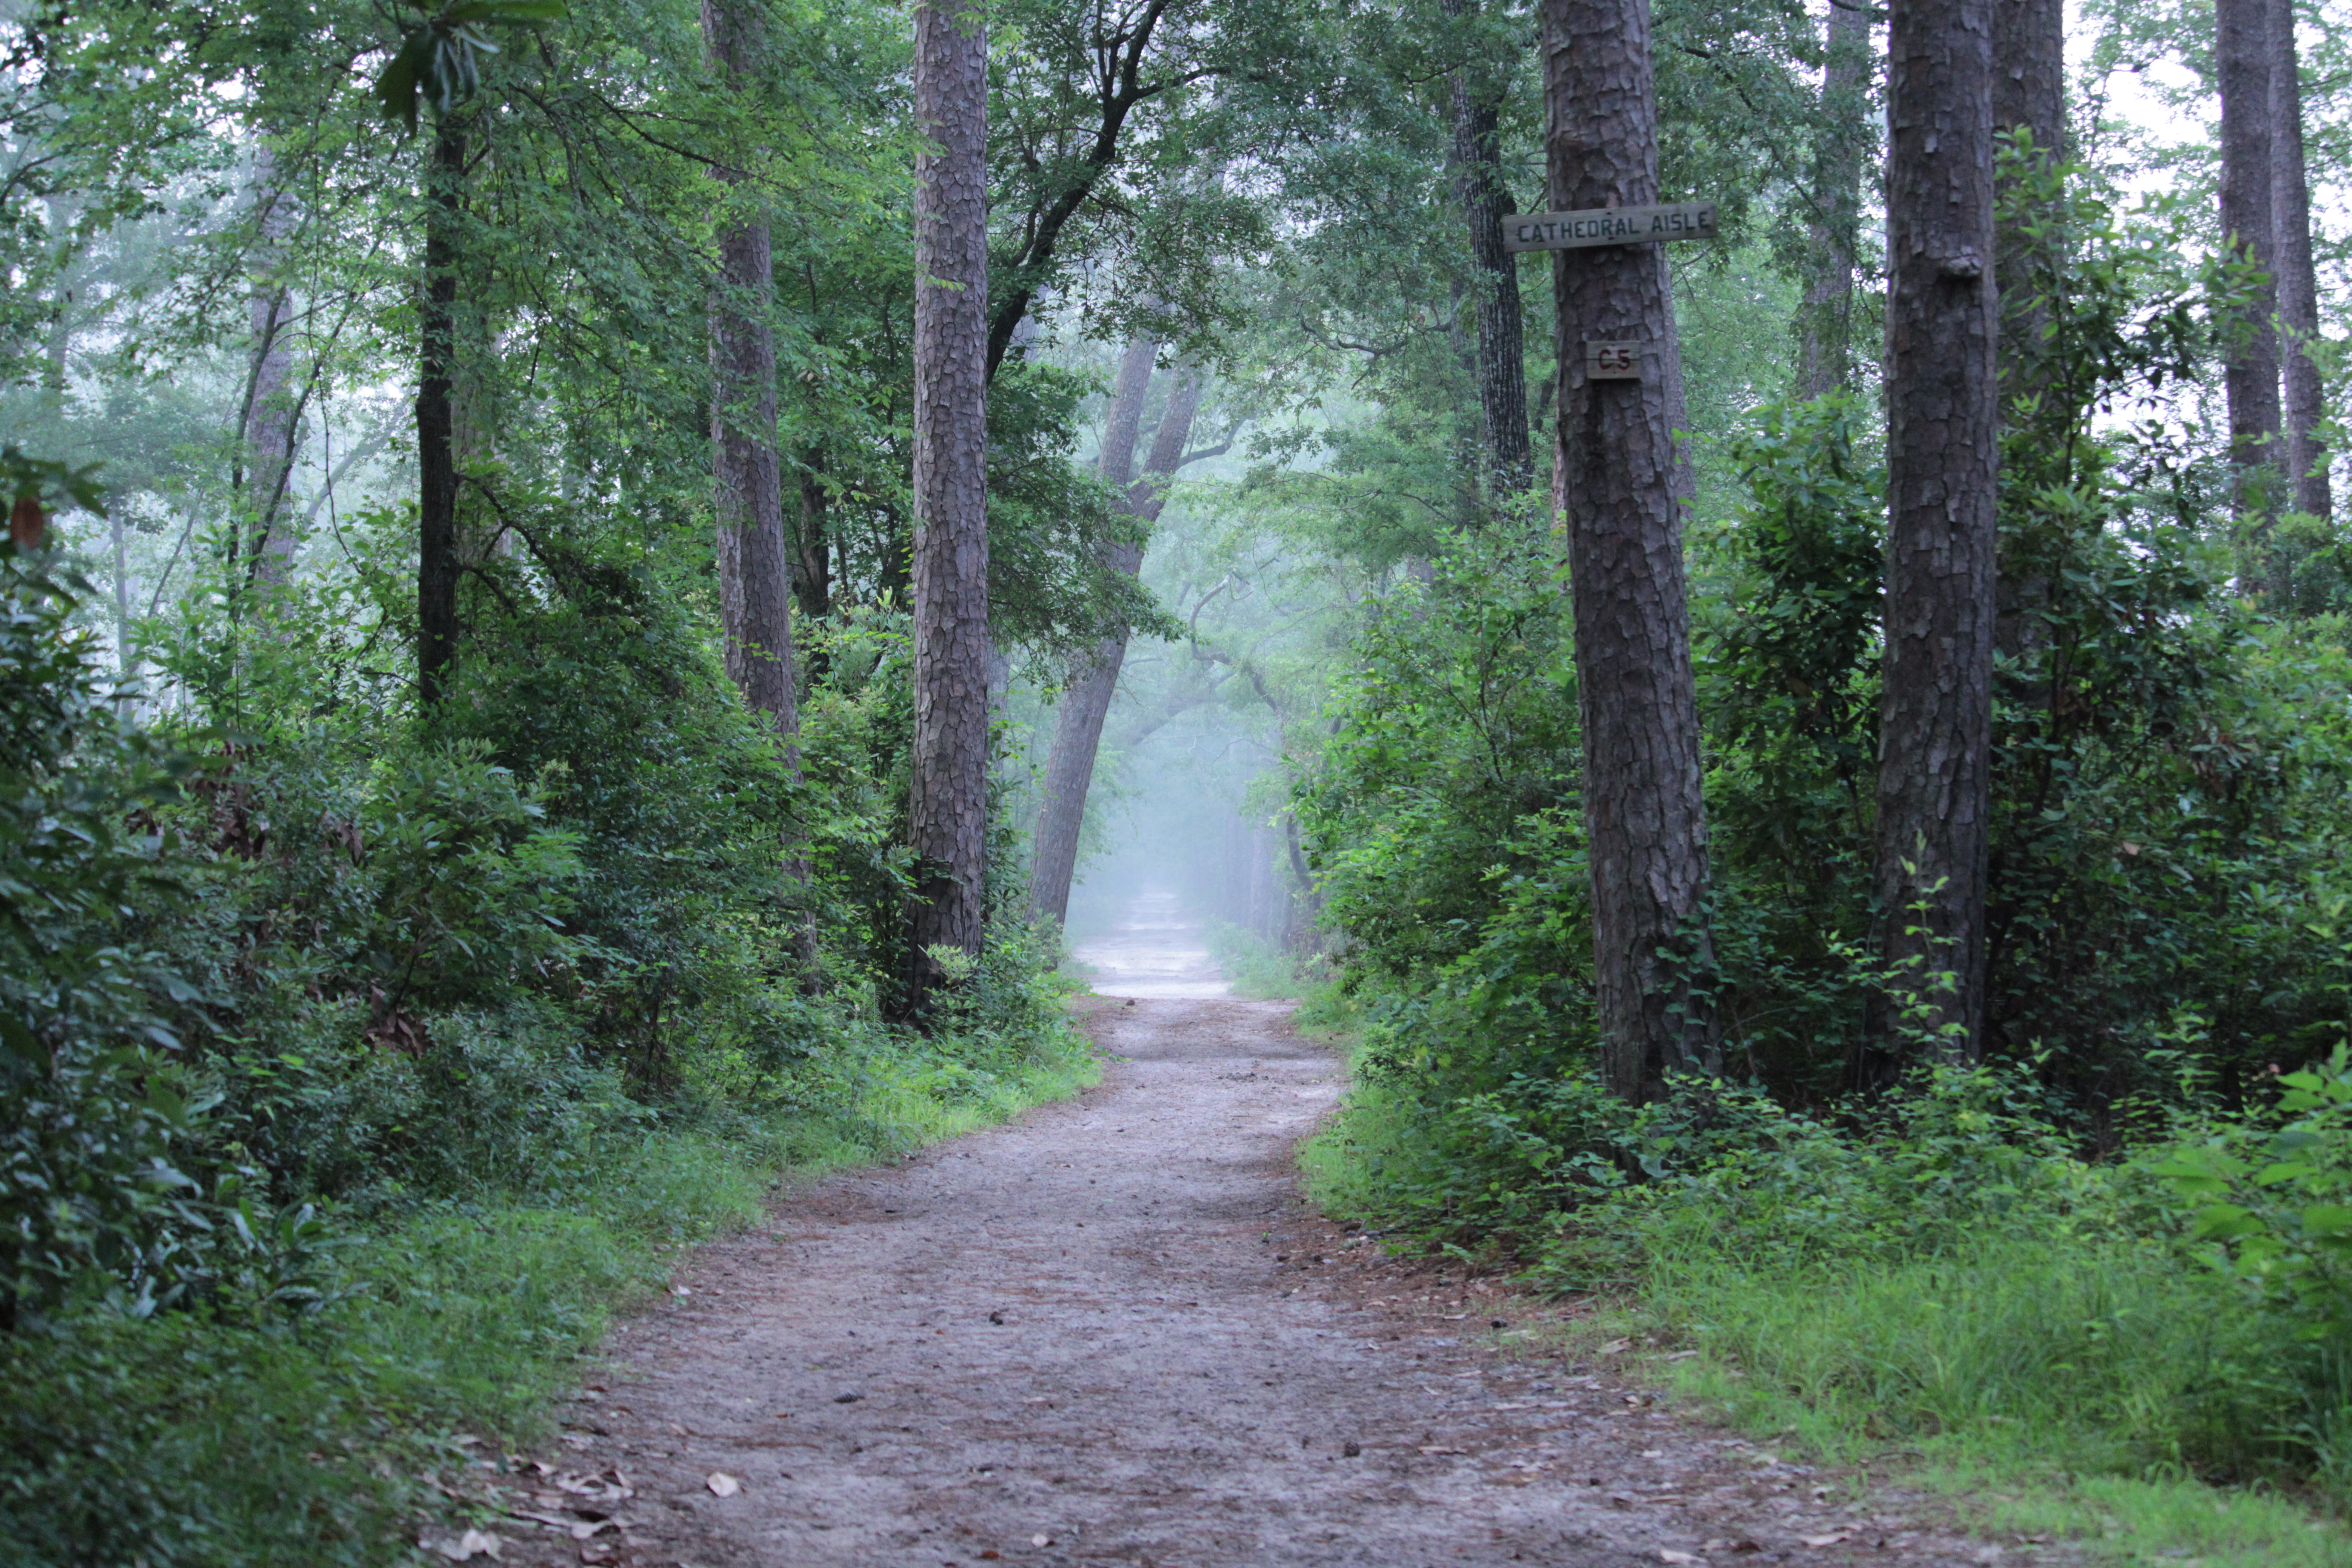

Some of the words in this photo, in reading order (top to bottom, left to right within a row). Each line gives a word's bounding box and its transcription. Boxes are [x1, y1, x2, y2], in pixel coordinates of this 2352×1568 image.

[1517, 217, 1640, 243] CATHEDRAL
[1651, 211, 1711, 232] AISLE
[1599, 349, 1630, 370] C5
